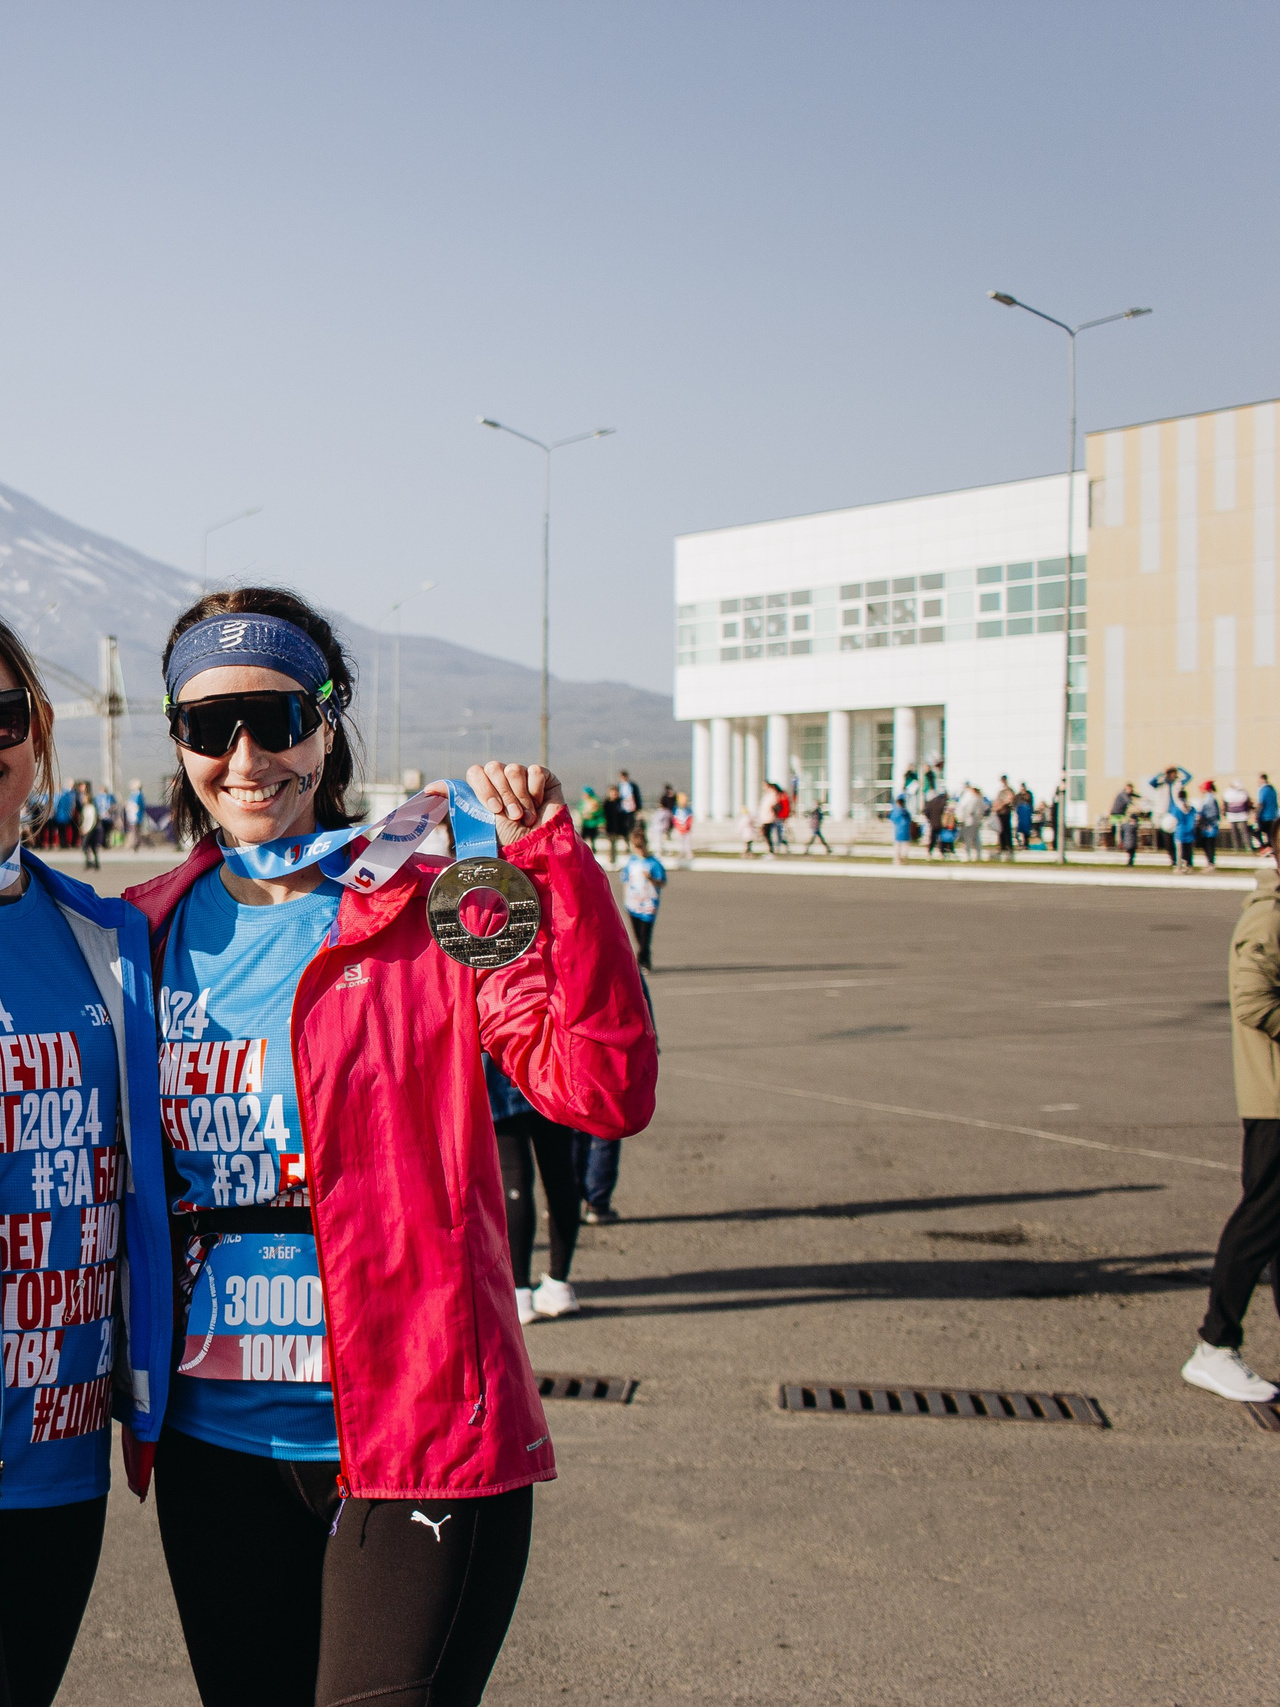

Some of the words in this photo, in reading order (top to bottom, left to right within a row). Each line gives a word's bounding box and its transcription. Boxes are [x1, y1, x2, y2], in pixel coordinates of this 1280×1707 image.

[302, 840, 331, 858] ПСБ
[159, 1039, 266, 1095] МЕЧТА
[161, 1095, 291, 1151] ЕГ2024
[223, 1274, 327, 1327] 3000
[238, 1333, 323, 1382] 10КМ
